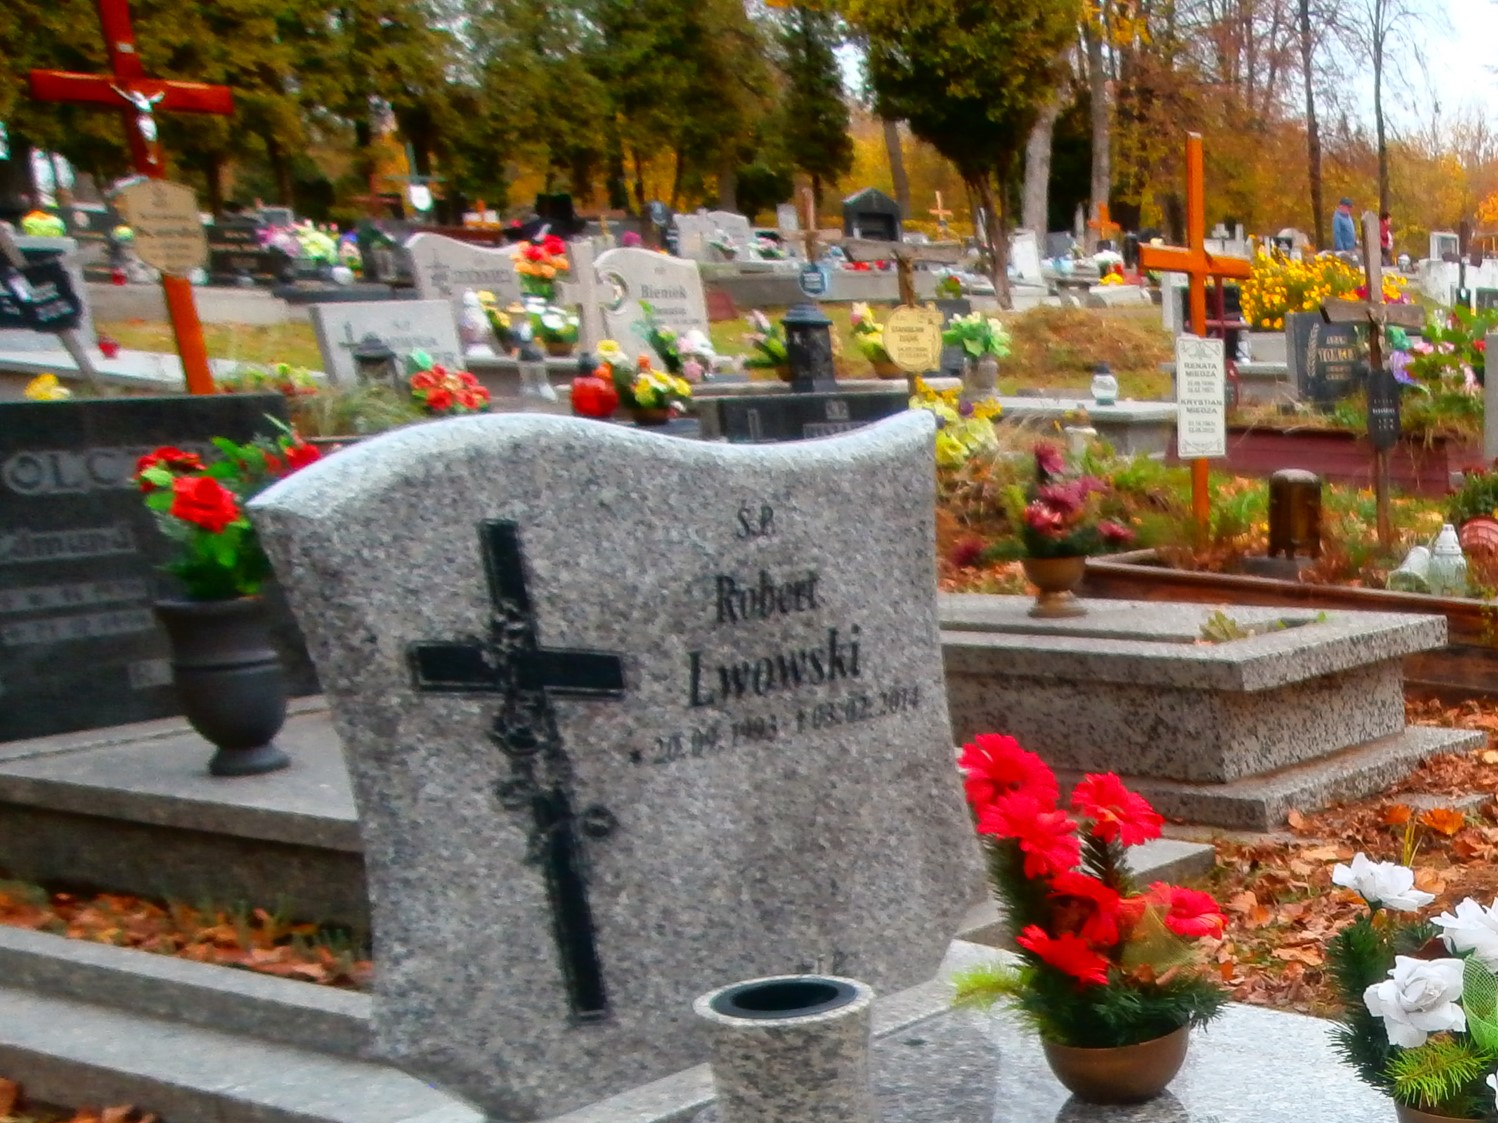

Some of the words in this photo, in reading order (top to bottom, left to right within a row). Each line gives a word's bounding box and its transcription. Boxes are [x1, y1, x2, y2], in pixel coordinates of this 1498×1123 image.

[1184, 362, 1217, 370] RENATA
[715, 569, 820, 625] Robert
[687, 624, 863, 708] Lwowski
